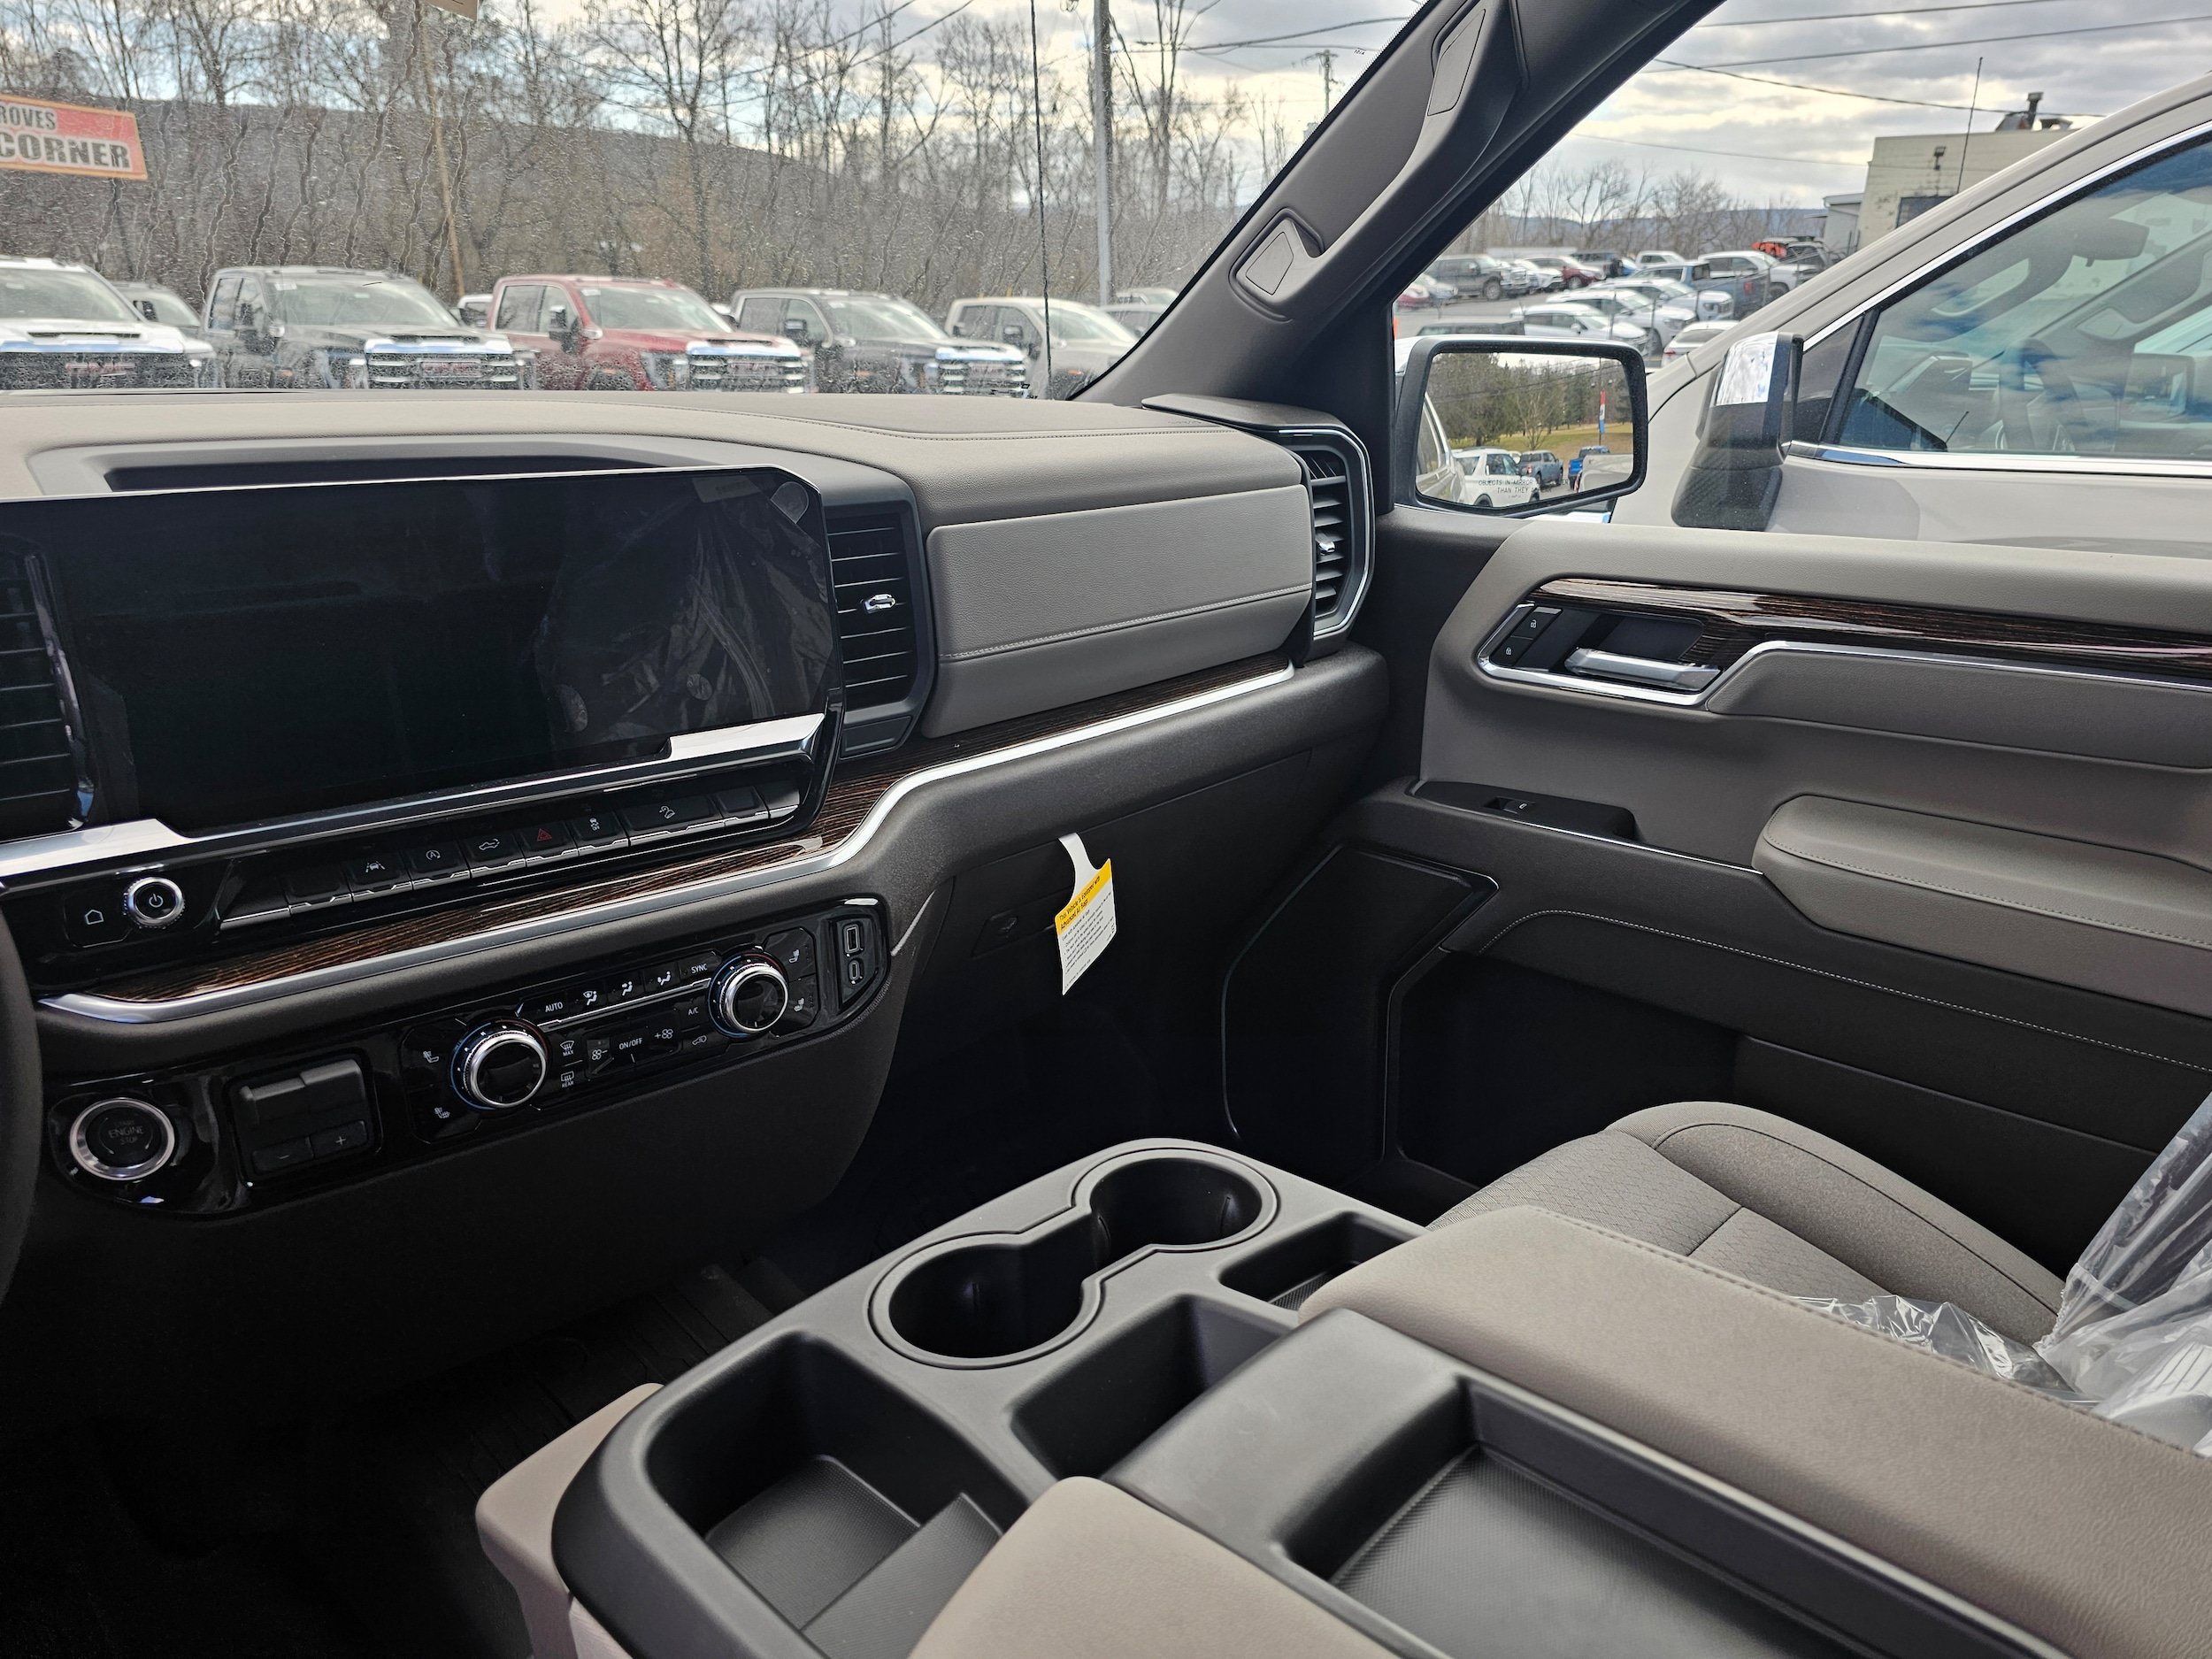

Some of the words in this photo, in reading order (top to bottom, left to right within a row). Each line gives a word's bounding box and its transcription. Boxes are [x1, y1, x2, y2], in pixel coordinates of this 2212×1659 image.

[0, 132, 131, 168] CORNER
[691, 964, 708, 973] SYNC
[545, 1002, 564, 1013] AUTO
[687, 1007, 699, 1016] A/C
[618, 1037, 643, 1050] ON/OFF
[108, 1125, 144, 1139] ENGINE
